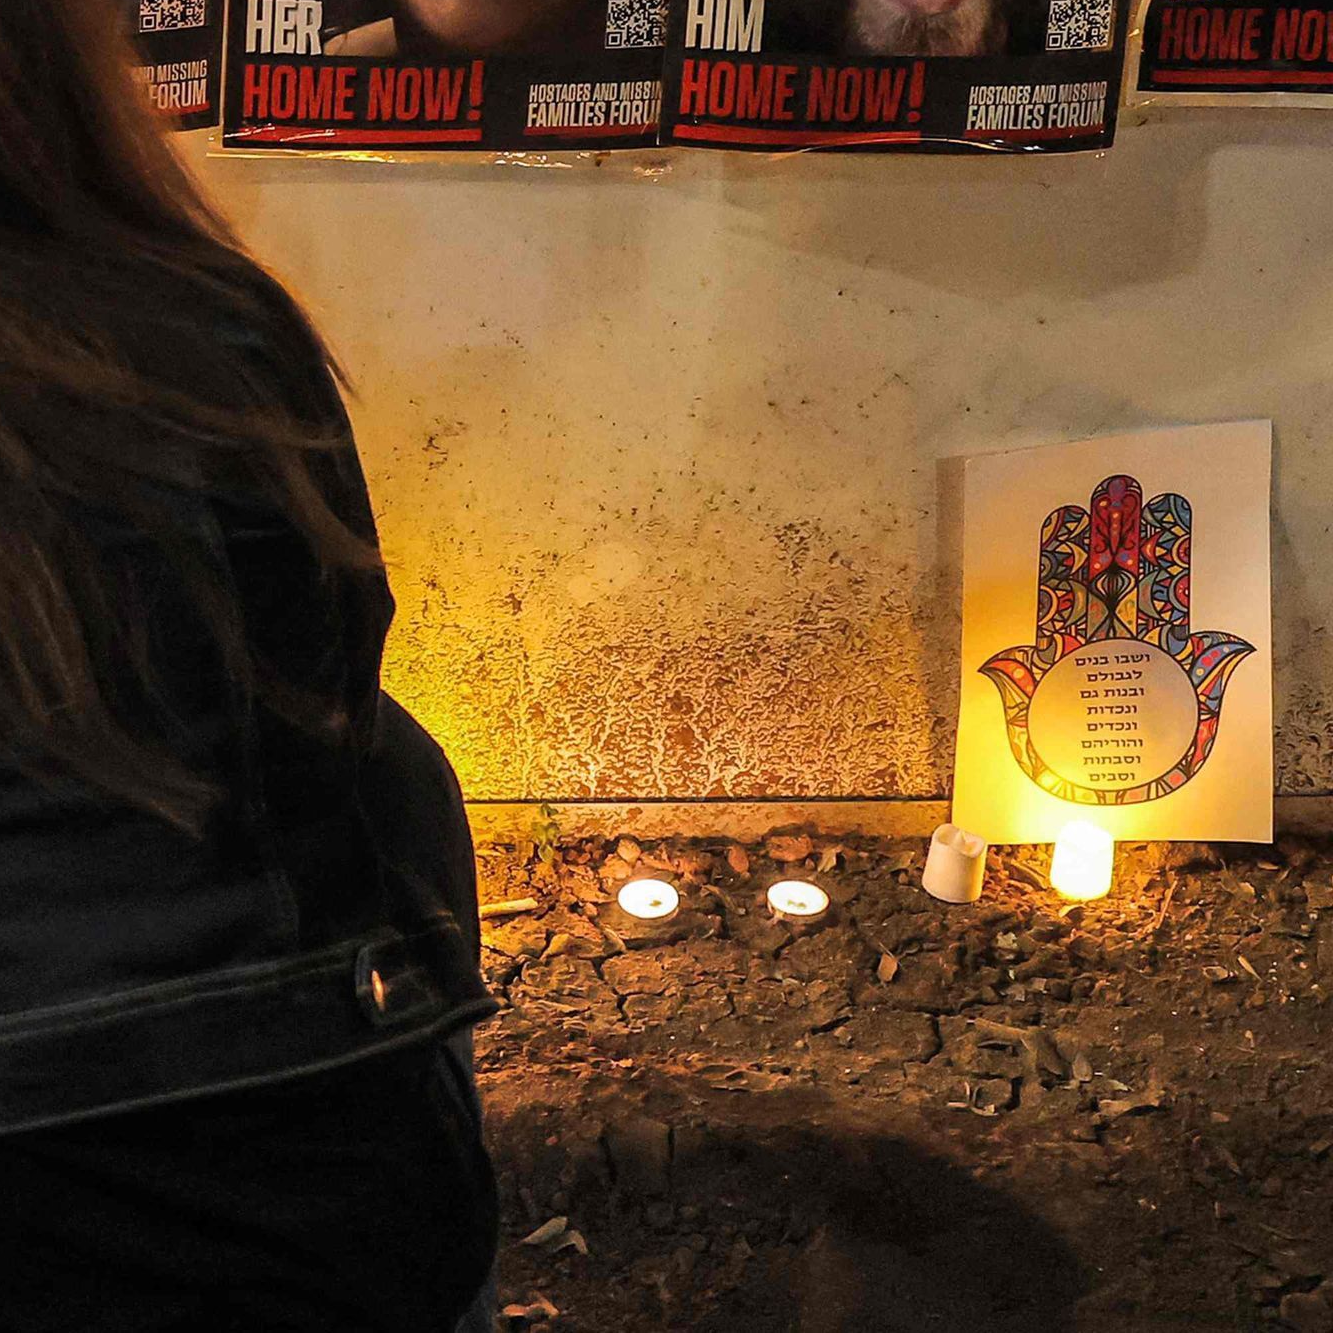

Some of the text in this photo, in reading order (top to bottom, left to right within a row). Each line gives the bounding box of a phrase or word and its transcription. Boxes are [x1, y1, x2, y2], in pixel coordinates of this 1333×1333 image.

[679, 59, 923, 122] HOME NOW!
[1075, 654, 1150, 666] ושבו בנים
[1087, 670, 1142, 682] לגבולם
[1080, 688, 1144, 698] ובנות גם
[1087, 705, 1137, 715] ונכדות
[1087, 722, 1137, 731] ונכדים
[1081, 739, 1143, 748] והוריהם
[1084, 756, 1140, 765] וסבתות
[1089, 773, 1135, 781] וסבים
